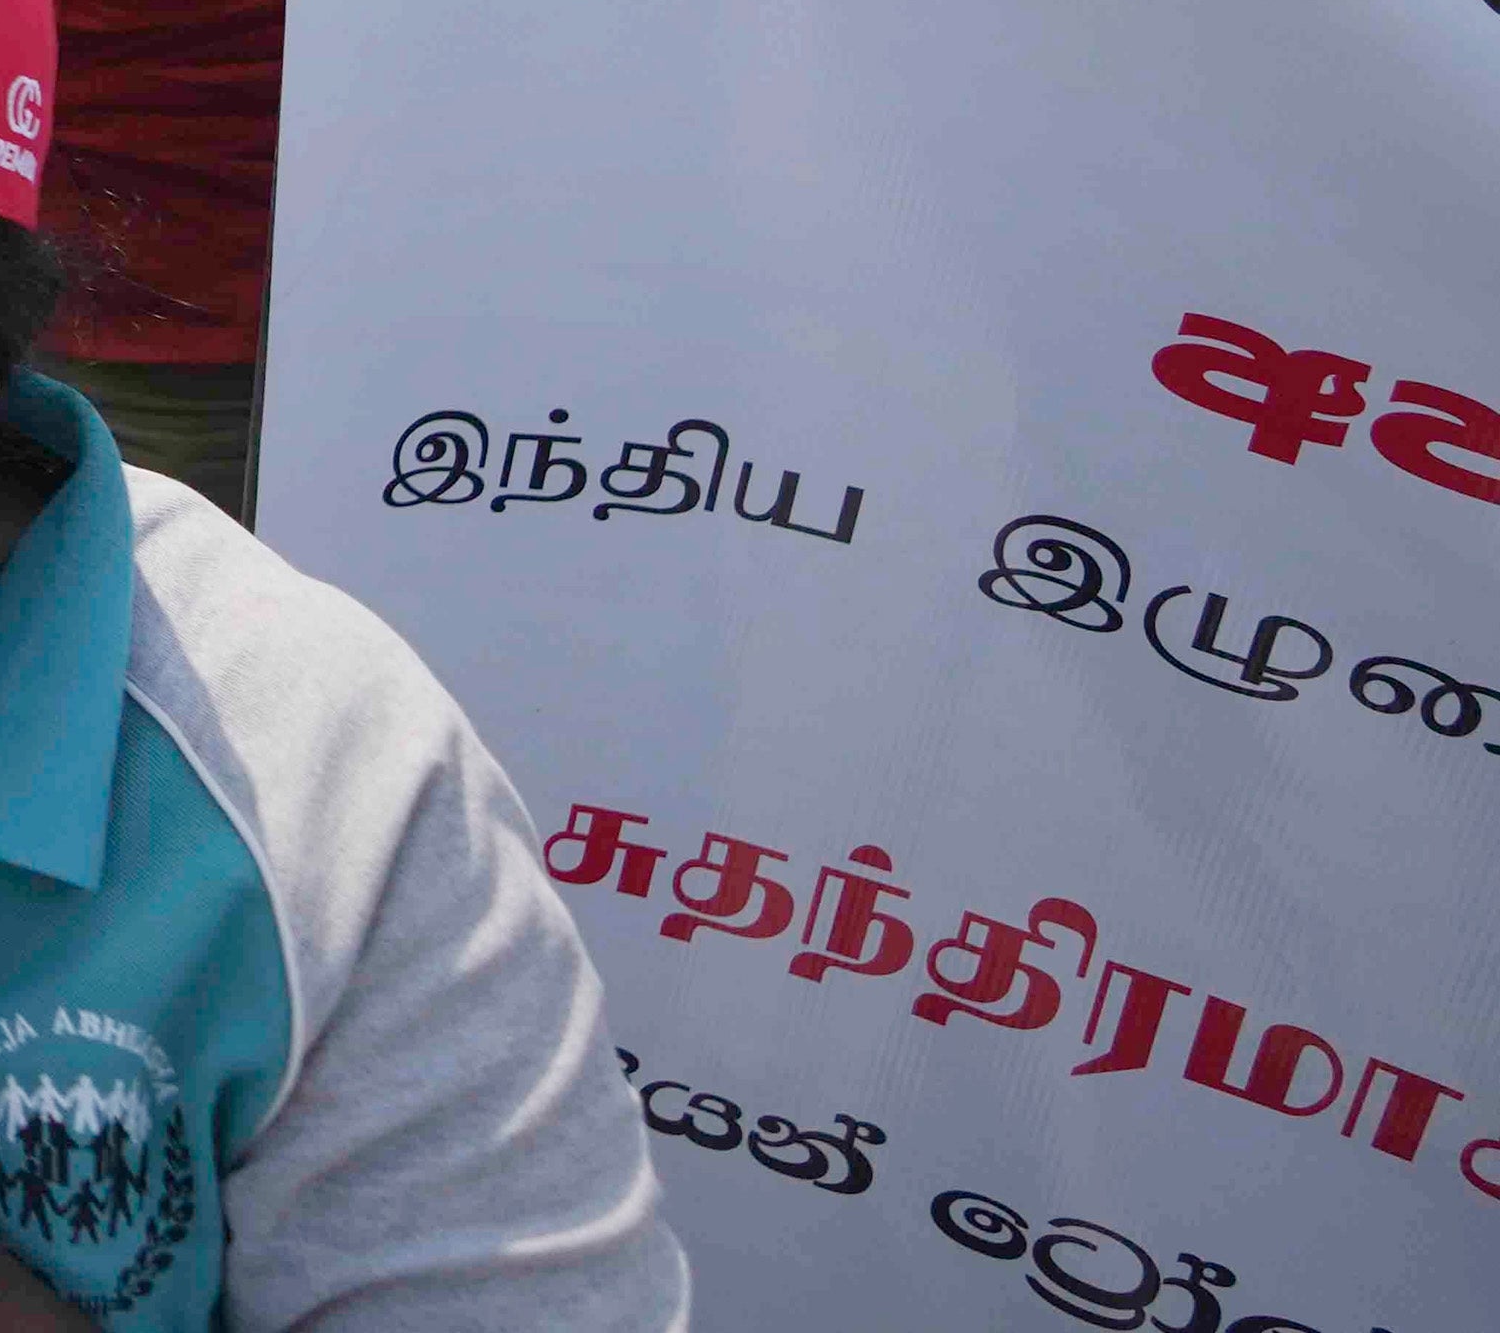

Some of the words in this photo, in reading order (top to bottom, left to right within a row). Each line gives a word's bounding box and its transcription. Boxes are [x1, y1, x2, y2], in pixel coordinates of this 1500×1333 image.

[381, 407, 866, 546] இந்திய
[542, 800, 1500, 1204] சுதந்திரமா
[612, 1044, 888, 1198] යන්
